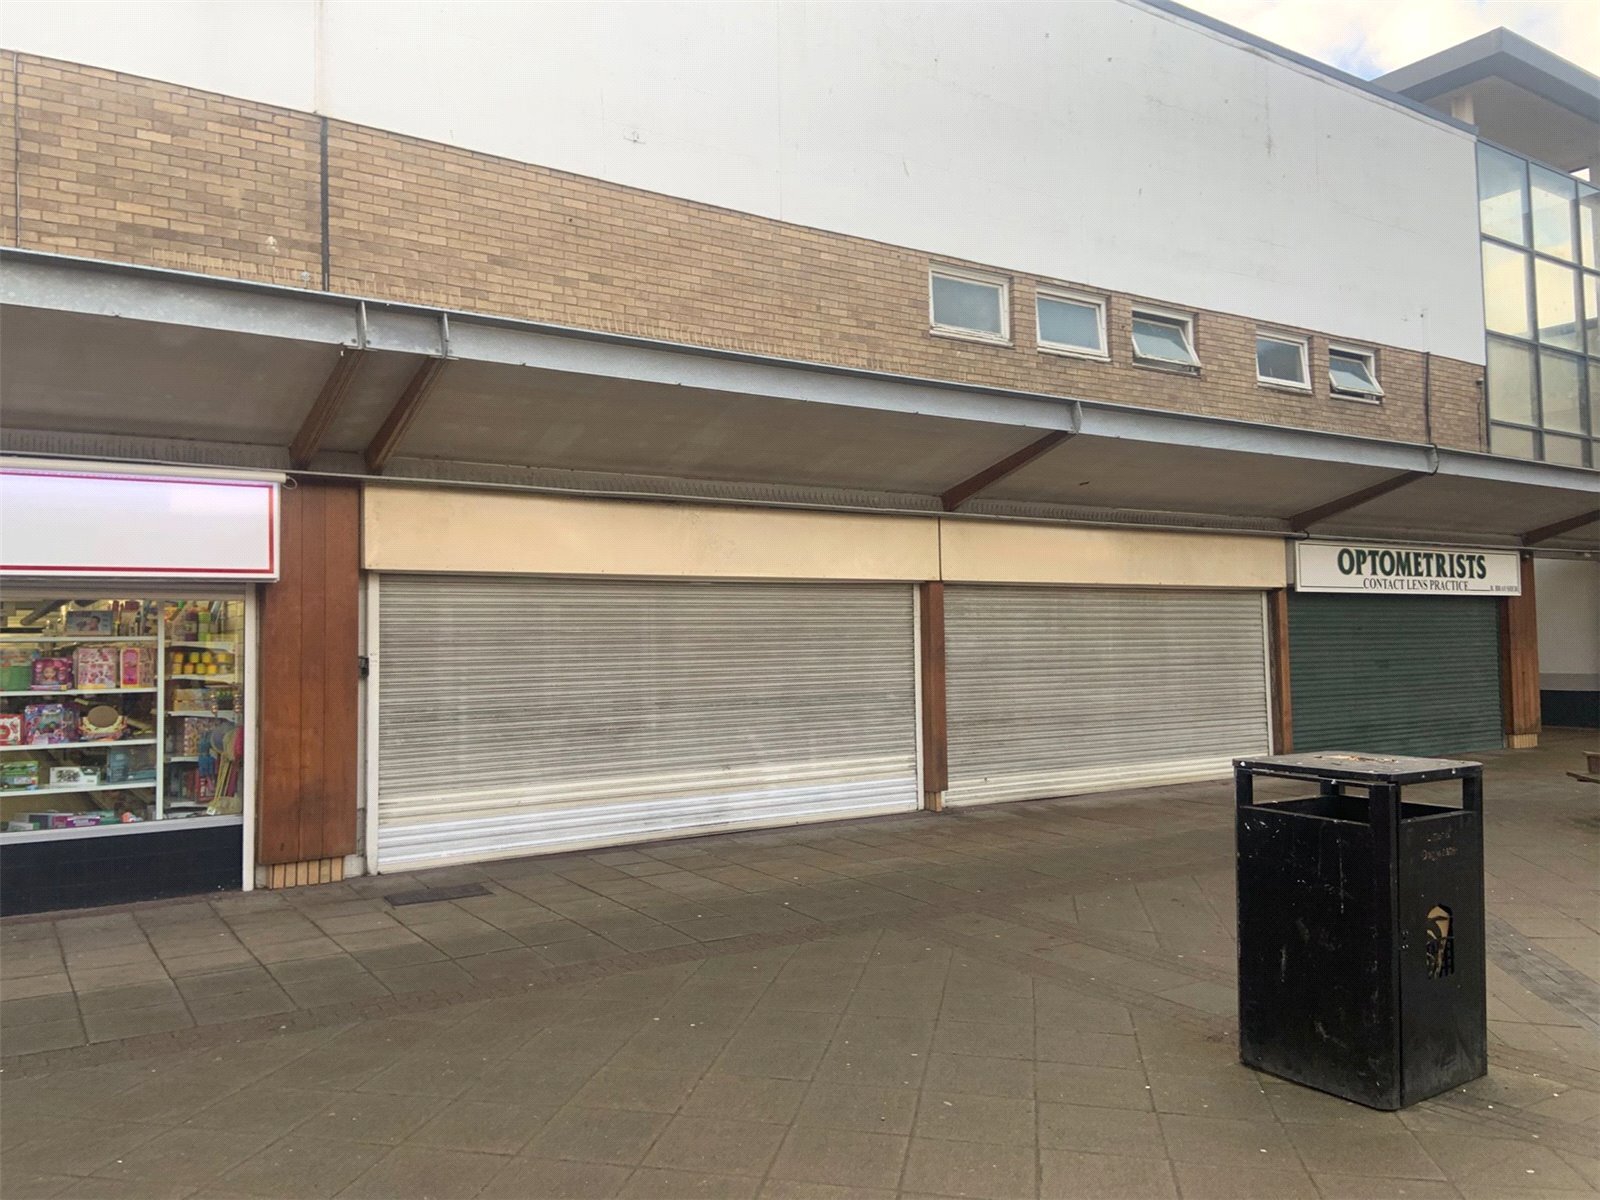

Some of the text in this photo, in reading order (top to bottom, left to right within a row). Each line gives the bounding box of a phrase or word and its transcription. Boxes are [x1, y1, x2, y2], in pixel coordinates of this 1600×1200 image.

[1337, 548, 1487, 579] OPTOMETRISTS
[1363, 577, 1469, 592] CONTACT LENS PRACTICE
